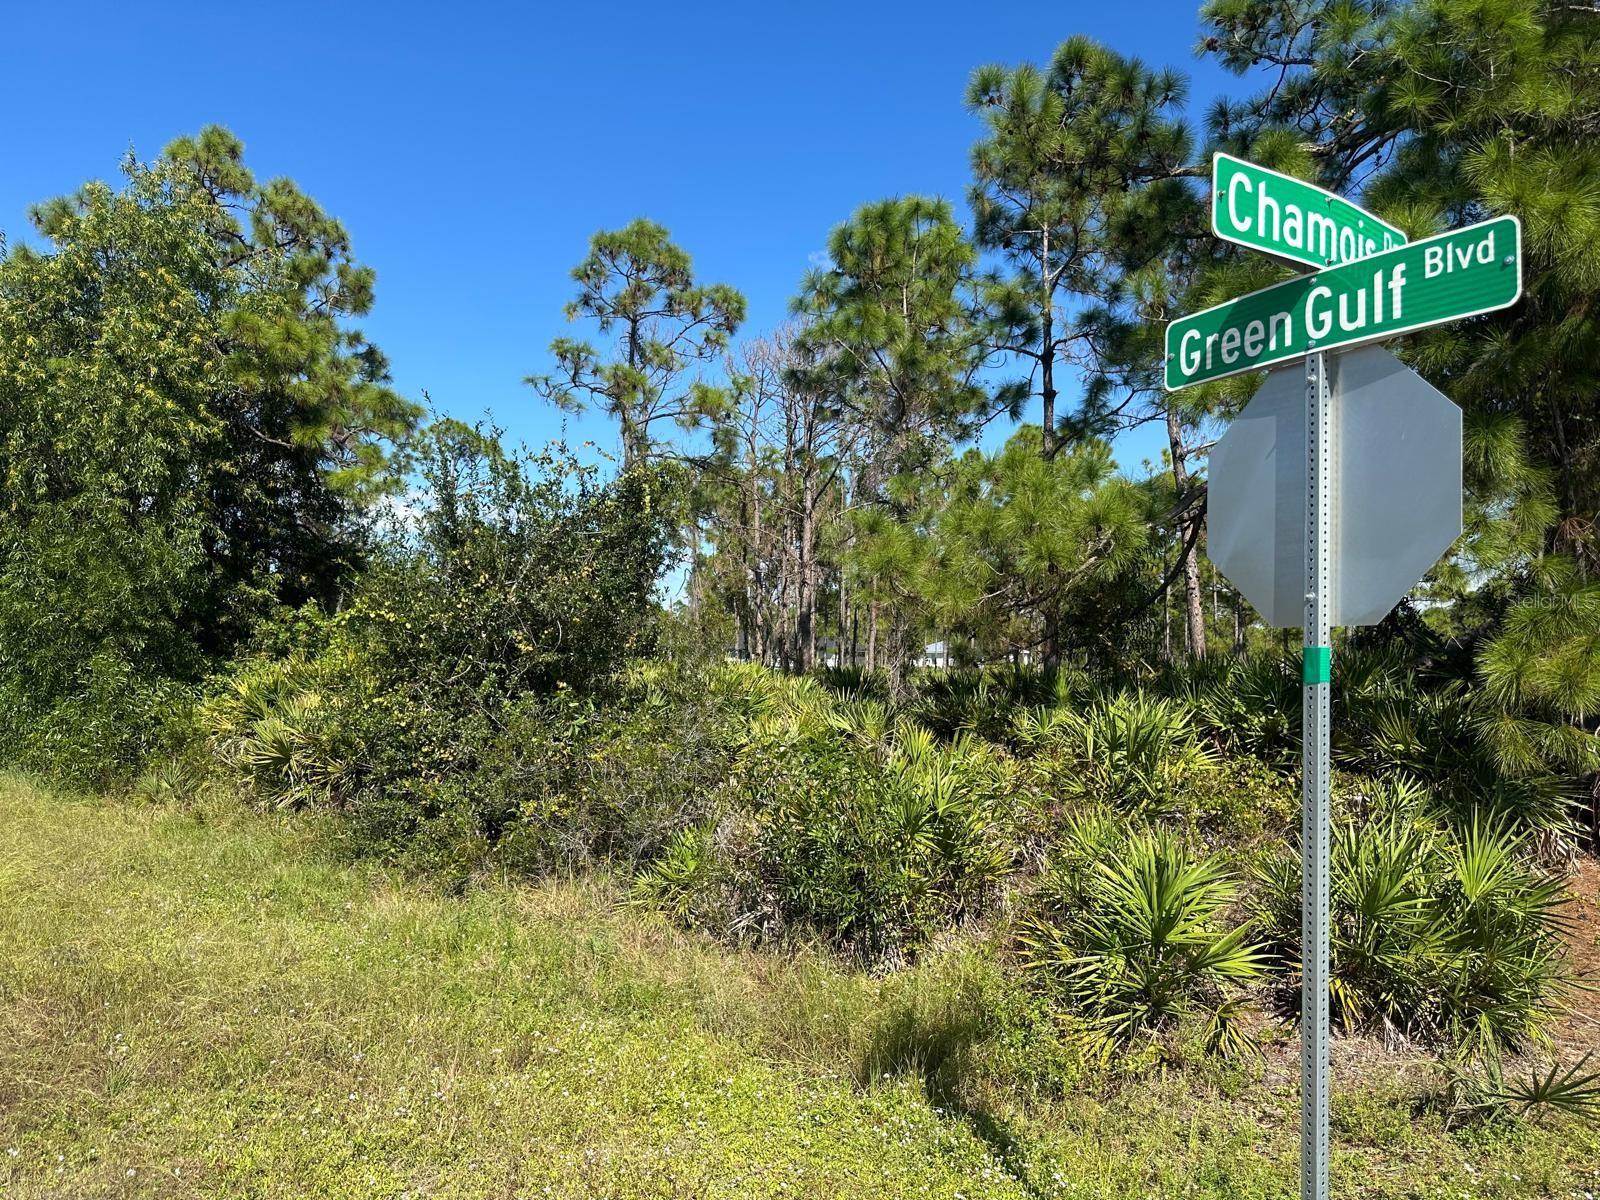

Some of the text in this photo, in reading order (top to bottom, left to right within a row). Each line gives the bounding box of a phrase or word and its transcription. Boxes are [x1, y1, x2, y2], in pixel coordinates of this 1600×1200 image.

[1383, 231, 1400, 251] D
[1179, 229, 1496, 377] Green Gulf Blvd
